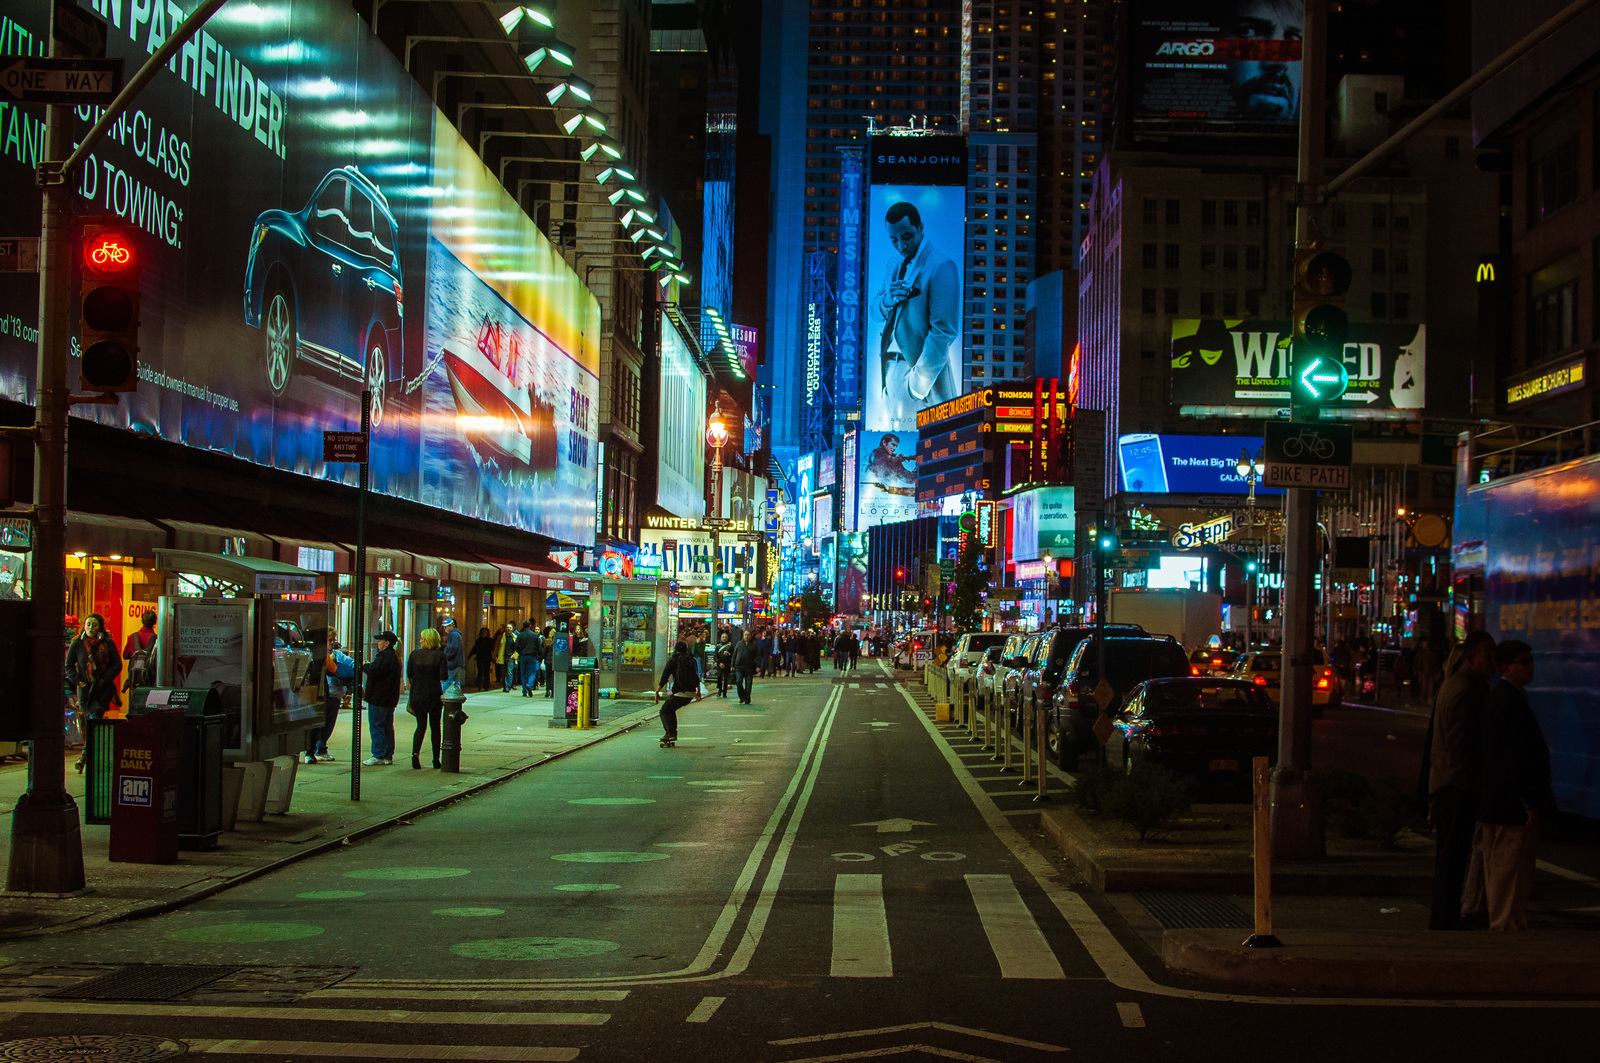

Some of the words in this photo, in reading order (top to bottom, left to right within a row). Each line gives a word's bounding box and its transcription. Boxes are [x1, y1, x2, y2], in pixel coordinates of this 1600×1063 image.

[1156, 42, 1215, 56] ARGO
[7, 71, 46, 88] ONE
[65, 73, 104, 89] WAY
[808, 302, 816, 340] EAGLE
[731, 327, 757, 344] RESORT
[813, 318, 821, 391] OUTFITTERS
[806, 343, 814, 406] AMERICAN
[154, 370, 166, 387] and
[166, 376, 187, 394] owner's
[187, 383, 206, 401] manual
[213, 393, 229, 411] proper
[998, 391, 1033, 399] THOMSON
[570, 386, 589, 431] BOAT
[568, 428, 588, 468] SHOW
[1172, 457, 1188, 466] The
[1189, 457, 1208, 466] Next
[1210, 457, 1224, 468] Big
[1220, 474, 1248, 482] GALAXY
[1271, 466, 1301, 482] BIKE
[1310, 467, 1345, 484] PATH
[1049, 503, 1062, 511] quite
[648, 516, 696, 529] WINTER
[1177, 508, 1244, 547] Snapple
[180, 636, 202, 644] MORE
[203, 636, 228, 644] OFTEN
[123, 748, 152, 760] FREE
[120, 760, 152, 771] DAILY
